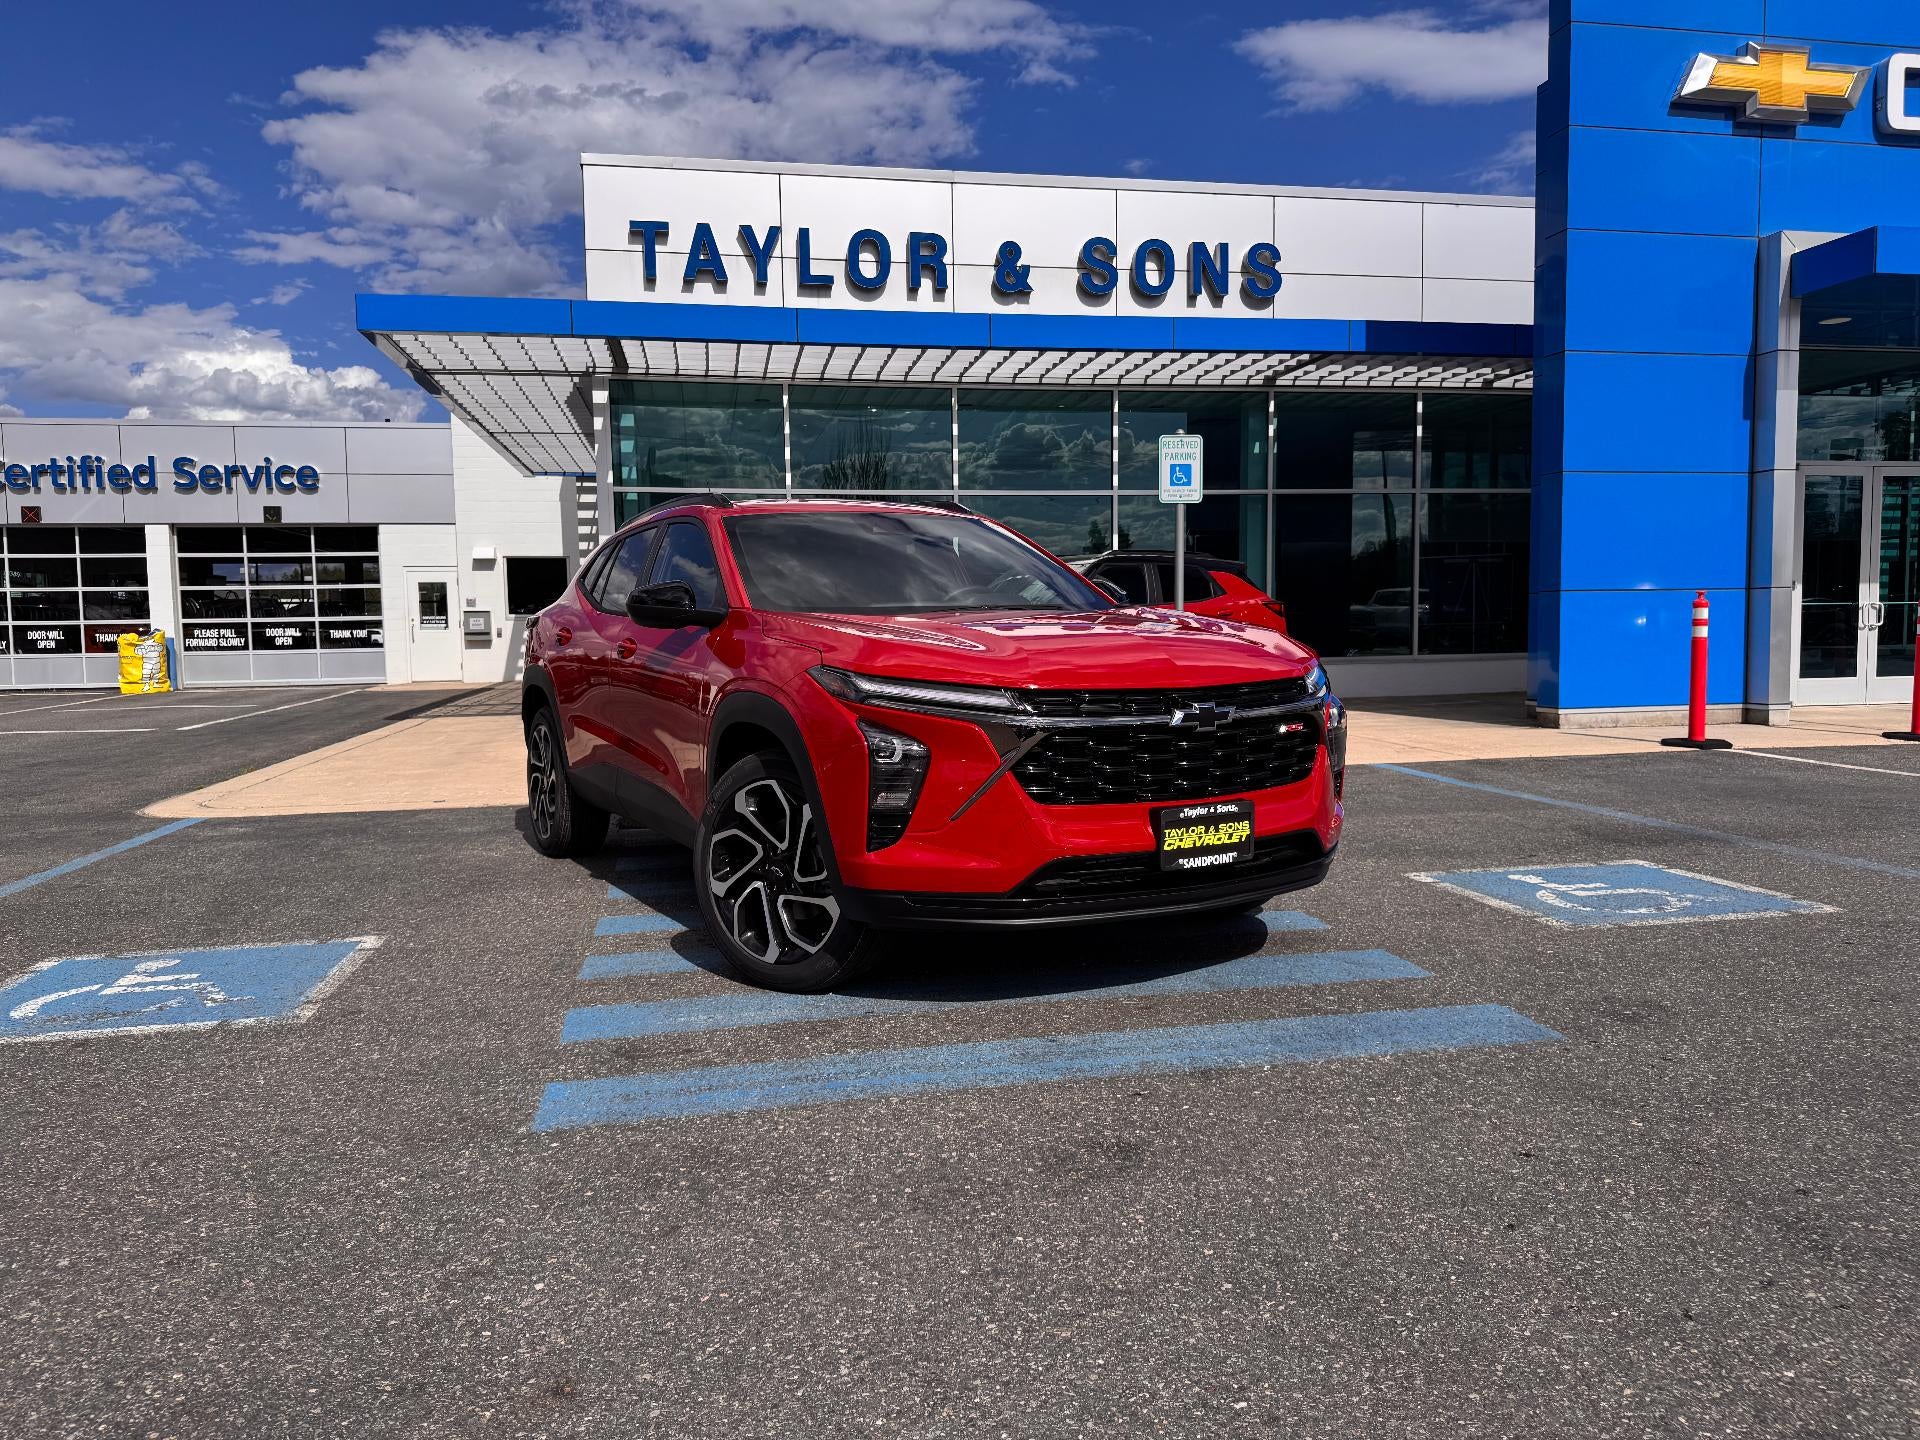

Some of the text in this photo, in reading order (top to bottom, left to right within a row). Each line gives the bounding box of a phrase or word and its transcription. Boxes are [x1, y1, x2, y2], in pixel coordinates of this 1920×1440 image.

[629, 220, 1283, 298] TAYLOR & SONS
[1162, 440, 1199, 449] RESERVED
[1164, 452, 1197, 461] PARKING
[0, 455, 320, 489] ertified Service
[27, 630, 65, 640] DOOR WILL
[194, 628, 237, 638] PLEASE PULL
[265, 627, 302, 637] DOOR WILL
[329, 629, 352, 639] THANK
[95, 633, 118, 643] THANK
[185, 637, 246, 647] FORWARD SLOWLY
[275, 637, 293, 646] OPEN
[37, 640, 56, 649] OPEN
[1184, 806, 1208, 819] Taylor
[1216, 804, 1236, 813] Sons
[1164, 820, 1250, 838] TAYLOR & SONS
[1163, 830, 1251, 851] CHEVROLET
[1183, 852, 1235, 869] SANDPOINT
